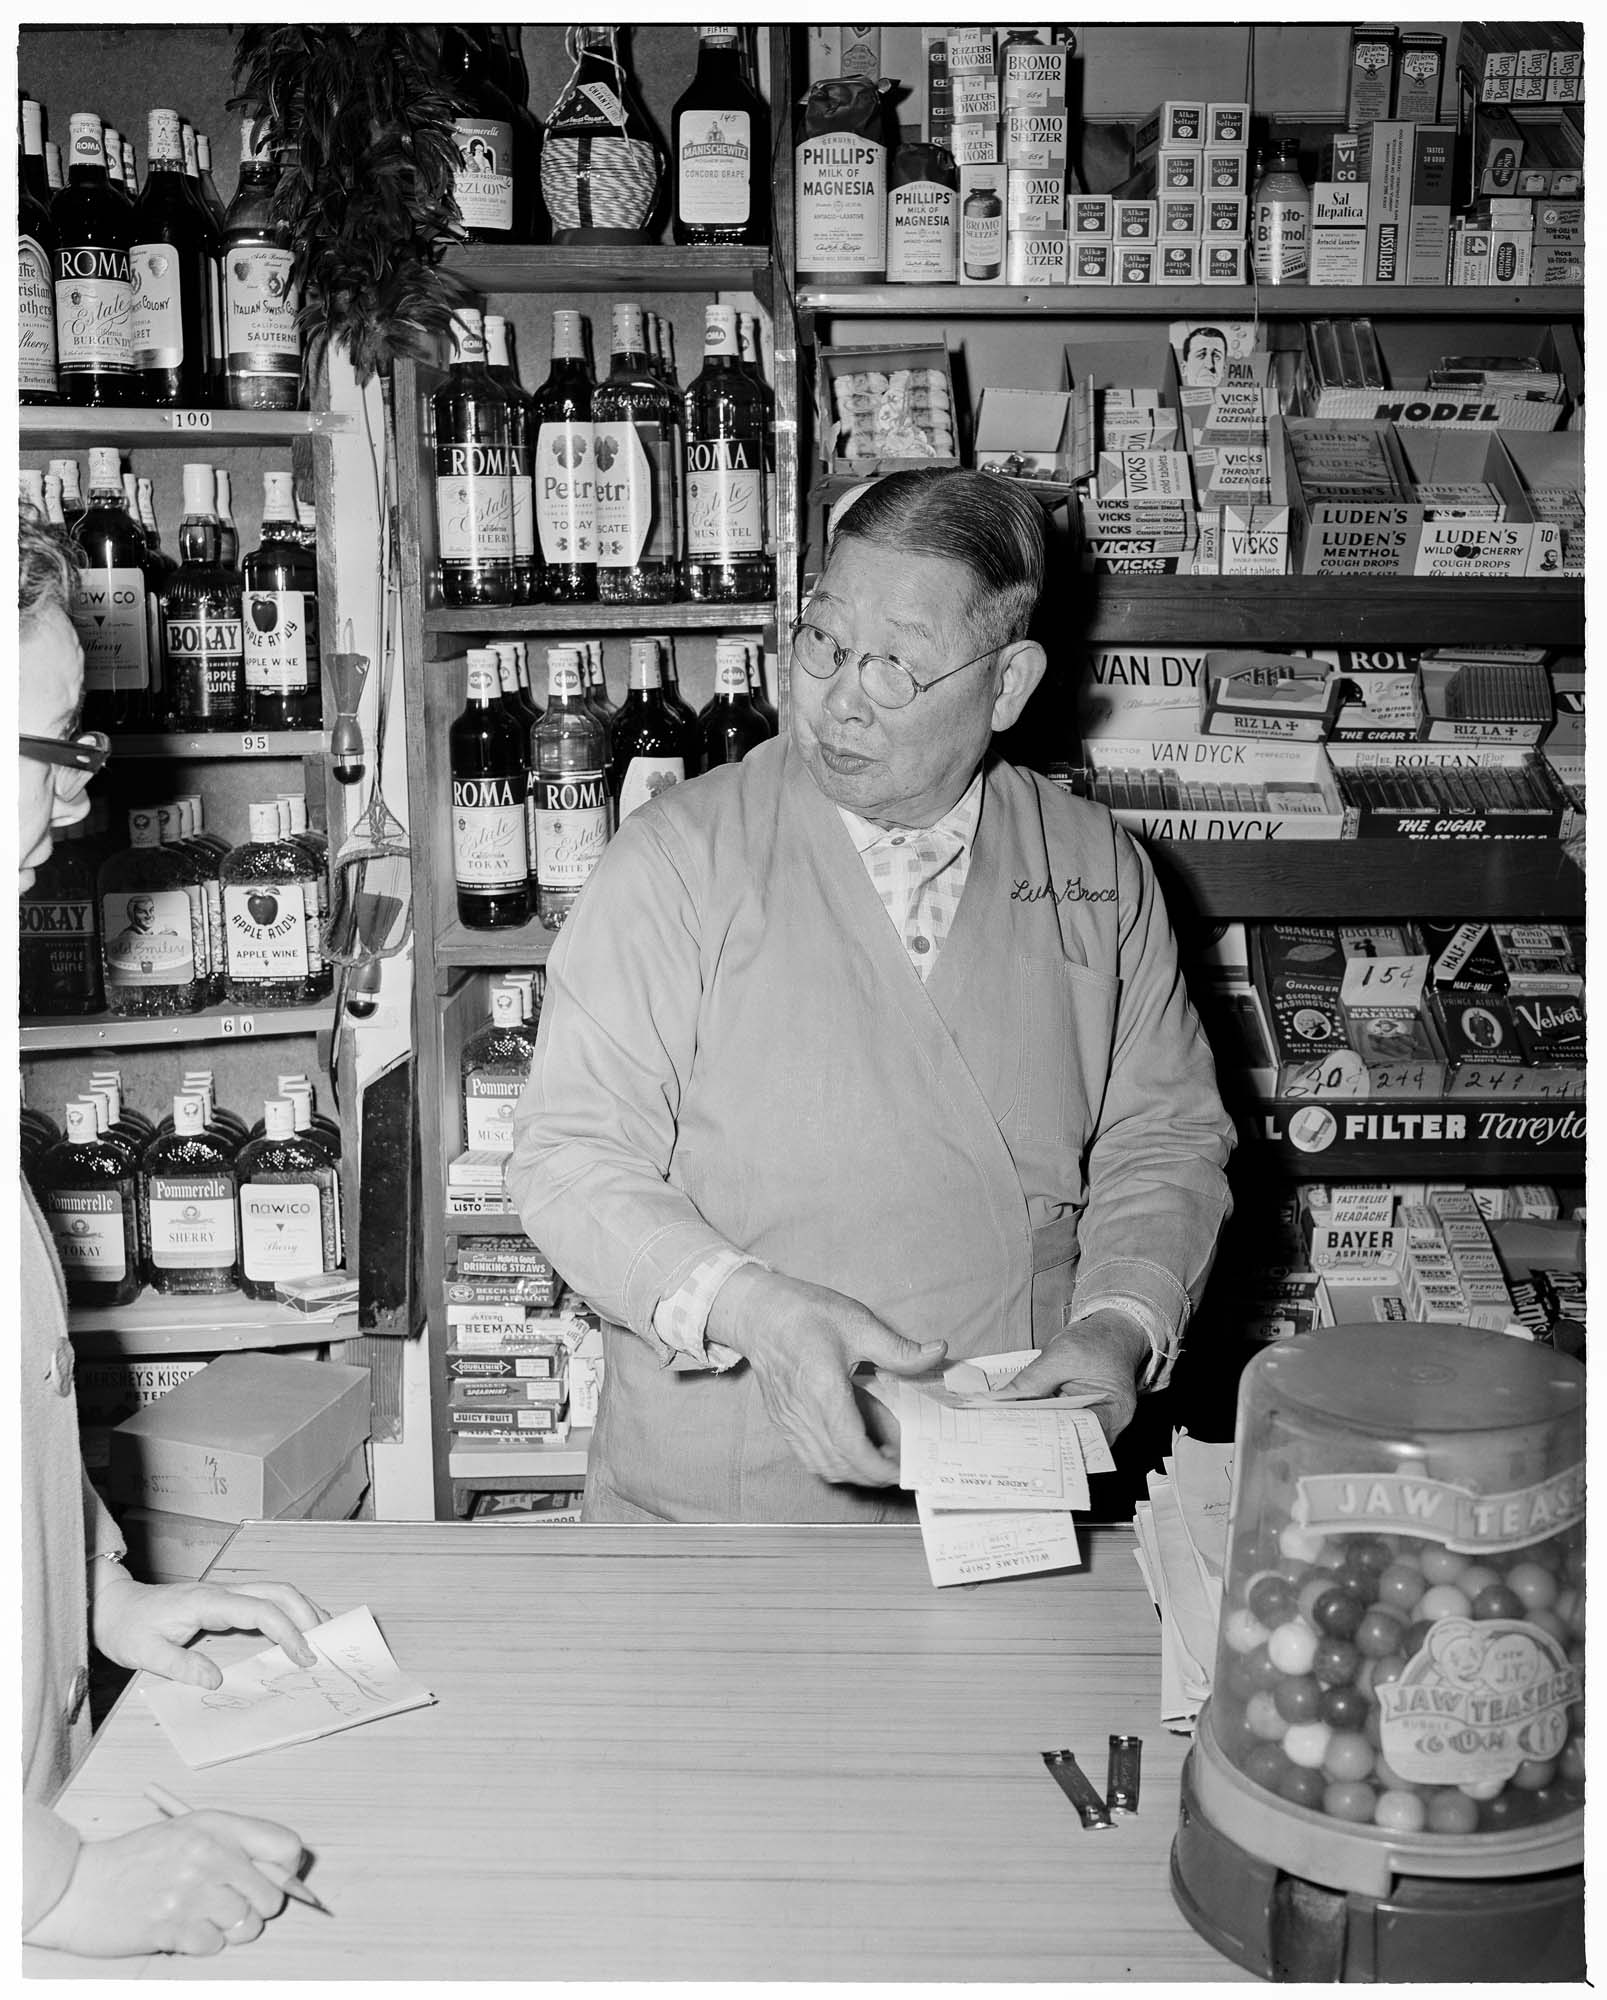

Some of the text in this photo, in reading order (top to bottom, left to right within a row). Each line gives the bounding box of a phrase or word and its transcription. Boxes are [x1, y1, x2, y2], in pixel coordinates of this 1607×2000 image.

[952, 54, 992, 66] BROMO
[1009, 56, 1061, 70] BROMO
[1009, 71, 1061, 80] SELTZER
[588, 85, 614, 111] CHIANTI
[1011, 118, 1062, 132] BROMO
[1174, 118, 1199, 126] Seltzer
[1011, 132, 1063, 142] SELTZER
[76, 142, 101, 150] ROMA
[684, 145, 748, 158] MANISCHEWITZ
[803, 148, 878, 165] PHILLIPS'
[685, 170, 745, 178] CONCORD GRAPE
[818, 168, 860, 178] MILK OF
[803, 181, 875, 196] MAGNESIA
[895, 192, 952, 204] PHILLIPS'
[1332, 192, 1350, 206] Sal
[907, 206, 940, 214] MILK OF
[1078, 210, 1105, 218] Seltzer
[1260, 206, 1305, 222] Pto-
[1317, 204, 1364, 220] Hepatica
[895, 216, 950, 226] MAGNESIA
[966, 220, 999, 230] BROMO
[1122, 216, 1149, 224] Seltzer
[1258, 224, 1306, 242] Bmol
[1471, 237, 1488, 253] 4
[1378, 227, 1396, 279] PERTUSSIN
[60, 250, 131, 280] ROMA
[19, 300, 52, 318] others
[142, 294, 170, 312] COLONY
[233, 300, 261, 315] ITALIAN
[73, 336, 131, 348] BURGUNDY
[247, 332, 297, 344] SAUTERNE
[1228, 364, 1254, 380] PAIN
[1220, 394, 1258, 404] VICKS
[1374, 402, 1500, 422] MODEL
[175, 412, 211, 428] 100
[1216, 416, 1268, 424] LOZENGES
[1304, 432, 1370, 442] LUDEN'S
[451, 448, 522, 476] ROMA
[687, 442, 748, 472] ROMA
[1224, 454, 1263, 466] VICKS
[1128, 457, 1148, 494] VICKS
[1222, 468, 1262, 476] THROAT
[544, 477, 593, 500] Petr
[596, 480, 630, 502] etri
[1096, 500, 1129, 509] VICKS
[1098, 512, 1132, 522] VICKS
[1322, 509, 1408, 524] LUDEN'S
[552, 520, 592, 530] TOAY
[1098, 526, 1132, 534] VICKS
[1322, 532, 1407, 546] LUDEN'S
[1435, 530, 1518, 544] LUDEN'S
[1540, 528, 1558, 542] 10¢
[1090, 540, 1153, 554] VICKS
[1204, 528, 1214, 559] VICKS
[1232, 536, 1279, 555] VICKS
[1323, 548, 1400, 558] MENTHOL
[1424, 546, 1524, 556] WILD CHERRY
[1106, 558, 1166, 574] VICKS
[1320, 558, 1400, 567] COUGH DROPS
[1432, 559, 1510, 568] COUGH DROPS
[80, 592, 136, 604] awco
[168, 626, 238, 652] BOKAY
[1351, 652, 1418, 670] ROI-
[207, 671, 238, 681] APPLE
[1090, 654, 1202, 688] VAN DY
[206, 682, 236, 692] WINE
[1234, 717, 1282, 730] RIZ LA
[1454, 725, 1500, 736] RIZ LA
[1340, 731, 1406, 740] THE CIGAR
[244, 736, 266, 750] 95
[1152, 742, 1248, 764] VAN DYCK
[1396, 754, 1480, 768] ROI-TAN
[454, 781, 514, 807] ROMA
[548, 784, 606, 810] ROMA
[1142, 818, 1284, 840] VAN DYCK
[1398, 819, 1486, 832] THE CIGAR
[468, 860, 510, 870] TOKAY
[548, 864, 586, 874] WHITE
[1064, 876, 1119, 902] Groce
[18, 904, 88, 932] BOKAY
[232, 912, 298, 941] APPLE ANDY
[1274, 924, 1336, 939] GRANGER
[50, 951, 86, 962] APPLE
[236, 949, 300, 959] APPLE WINE
[52, 962, 86, 972] WINE
[1362, 964, 1414, 989] 15¢
[1286, 980, 1340, 992] GRANGER
[1275, 1000, 1338, 1010] WASHINGTON
[1516, 1002, 1583, 1037] Velvet
[471, 1078, 527, 1097] Pommere
[1344, 1114, 1466, 1140] FILTER
[156, 1180, 226, 1200] Pommerelle
[1336, 1195, 1389, 1204] FAST RELIEF
[250, 1201, 312, 1215] nawico
[454, 1203, 482, 1213] LISTO
[1334, 1212, 1390, 1222] HEADACHE
[168, 1231, 217, 1244] SHERRY
[1327, 1231, 1394, 1248] BAYER
[1336, 1250, 1381, 1258] ASPIRIN
[464, 1264, 546, 1273] DRINKING STRAWS
[464, 1324, 534, 1334] BEEMANS
[456, 1414, 511, 1422] JUICY FRUIT
[998, 1478, 1030, 1488] ARDEN
[1338, 1483, 1572, 1537] JAW TEAS
[959, 1552, 1050, 1574] WILLIAMS CHIPS
[1393, 1688, 1461, 1712] JAW
